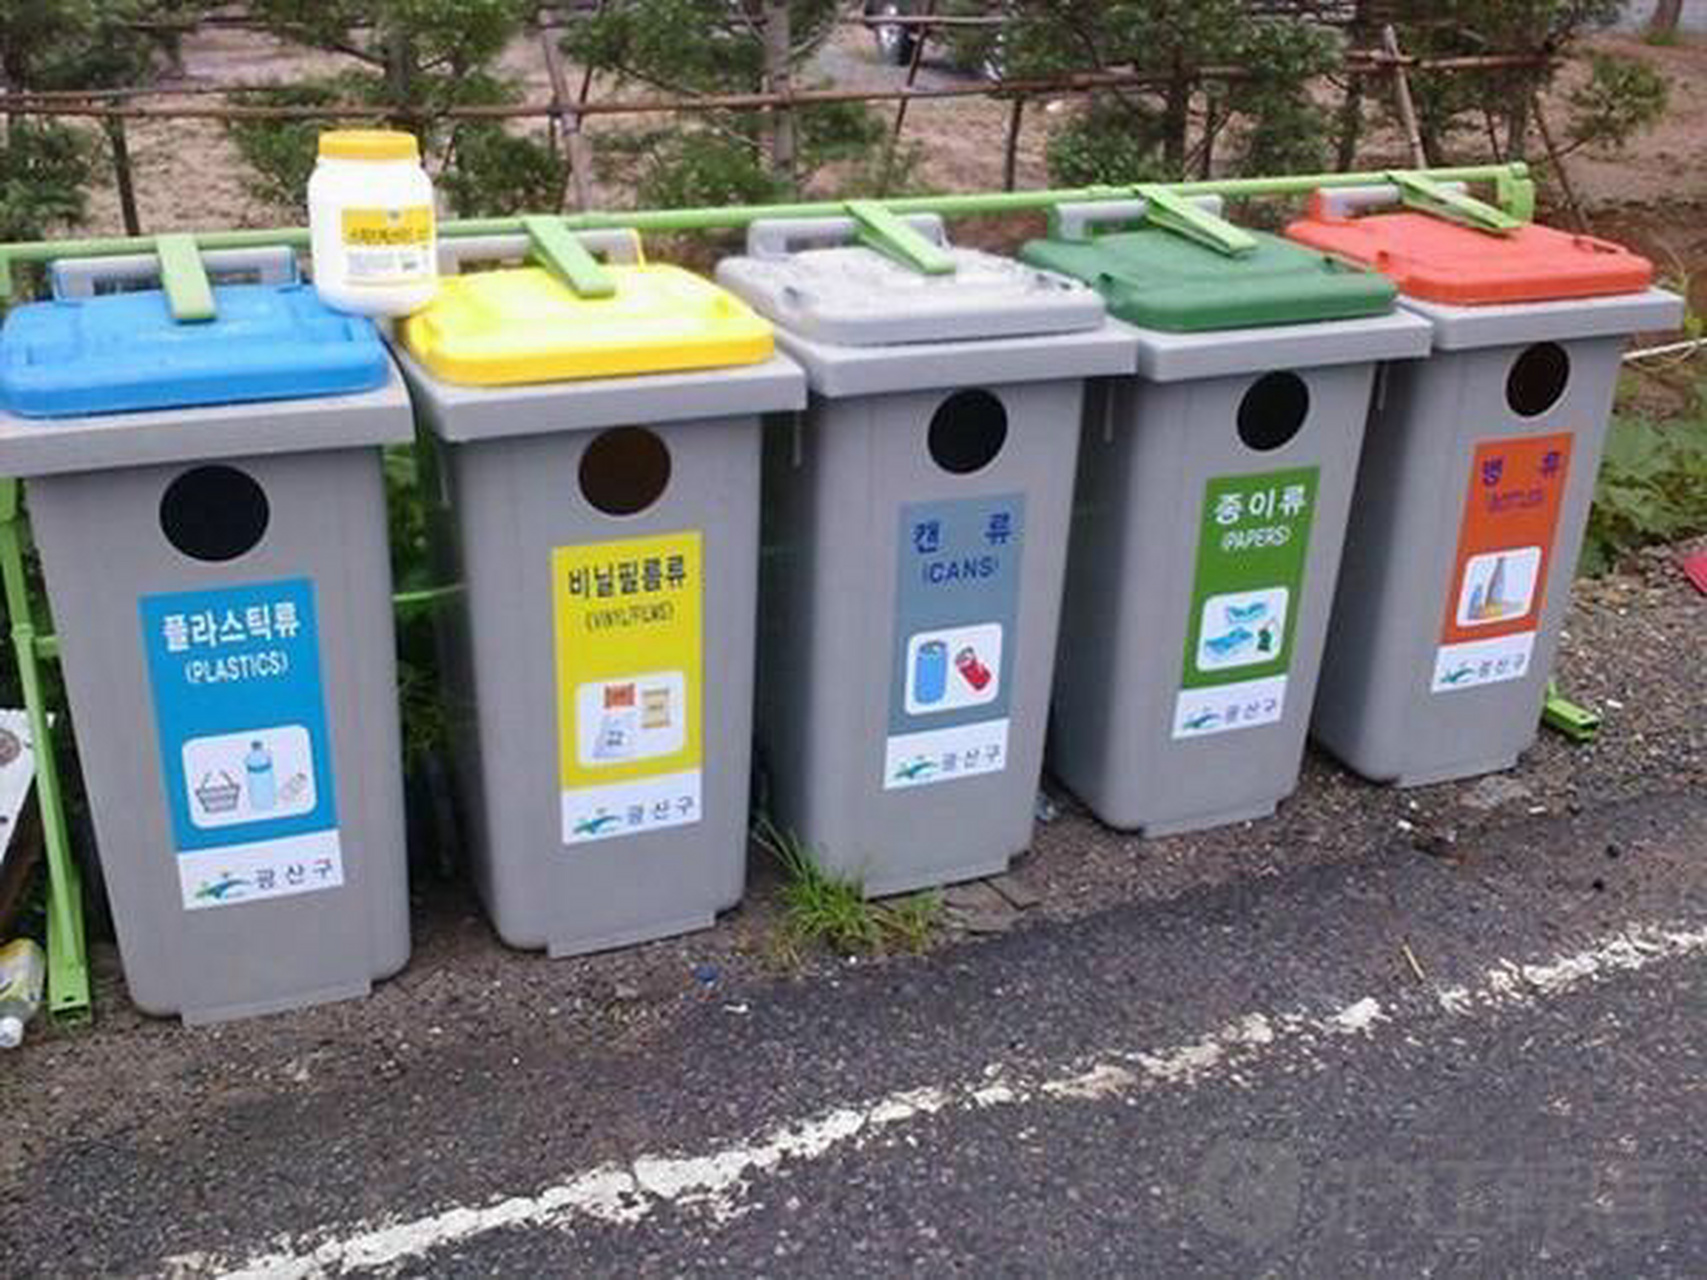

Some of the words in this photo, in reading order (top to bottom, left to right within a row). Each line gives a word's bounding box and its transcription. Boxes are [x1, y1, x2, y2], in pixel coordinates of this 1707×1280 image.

[1215, 485, 1306, 524] 종이류
[568, 554, 687, 600] 비닐필름류
[163, 601, 300, 653] 플라스틱류
[184, 649, 289, 684] (PLASTICS)
